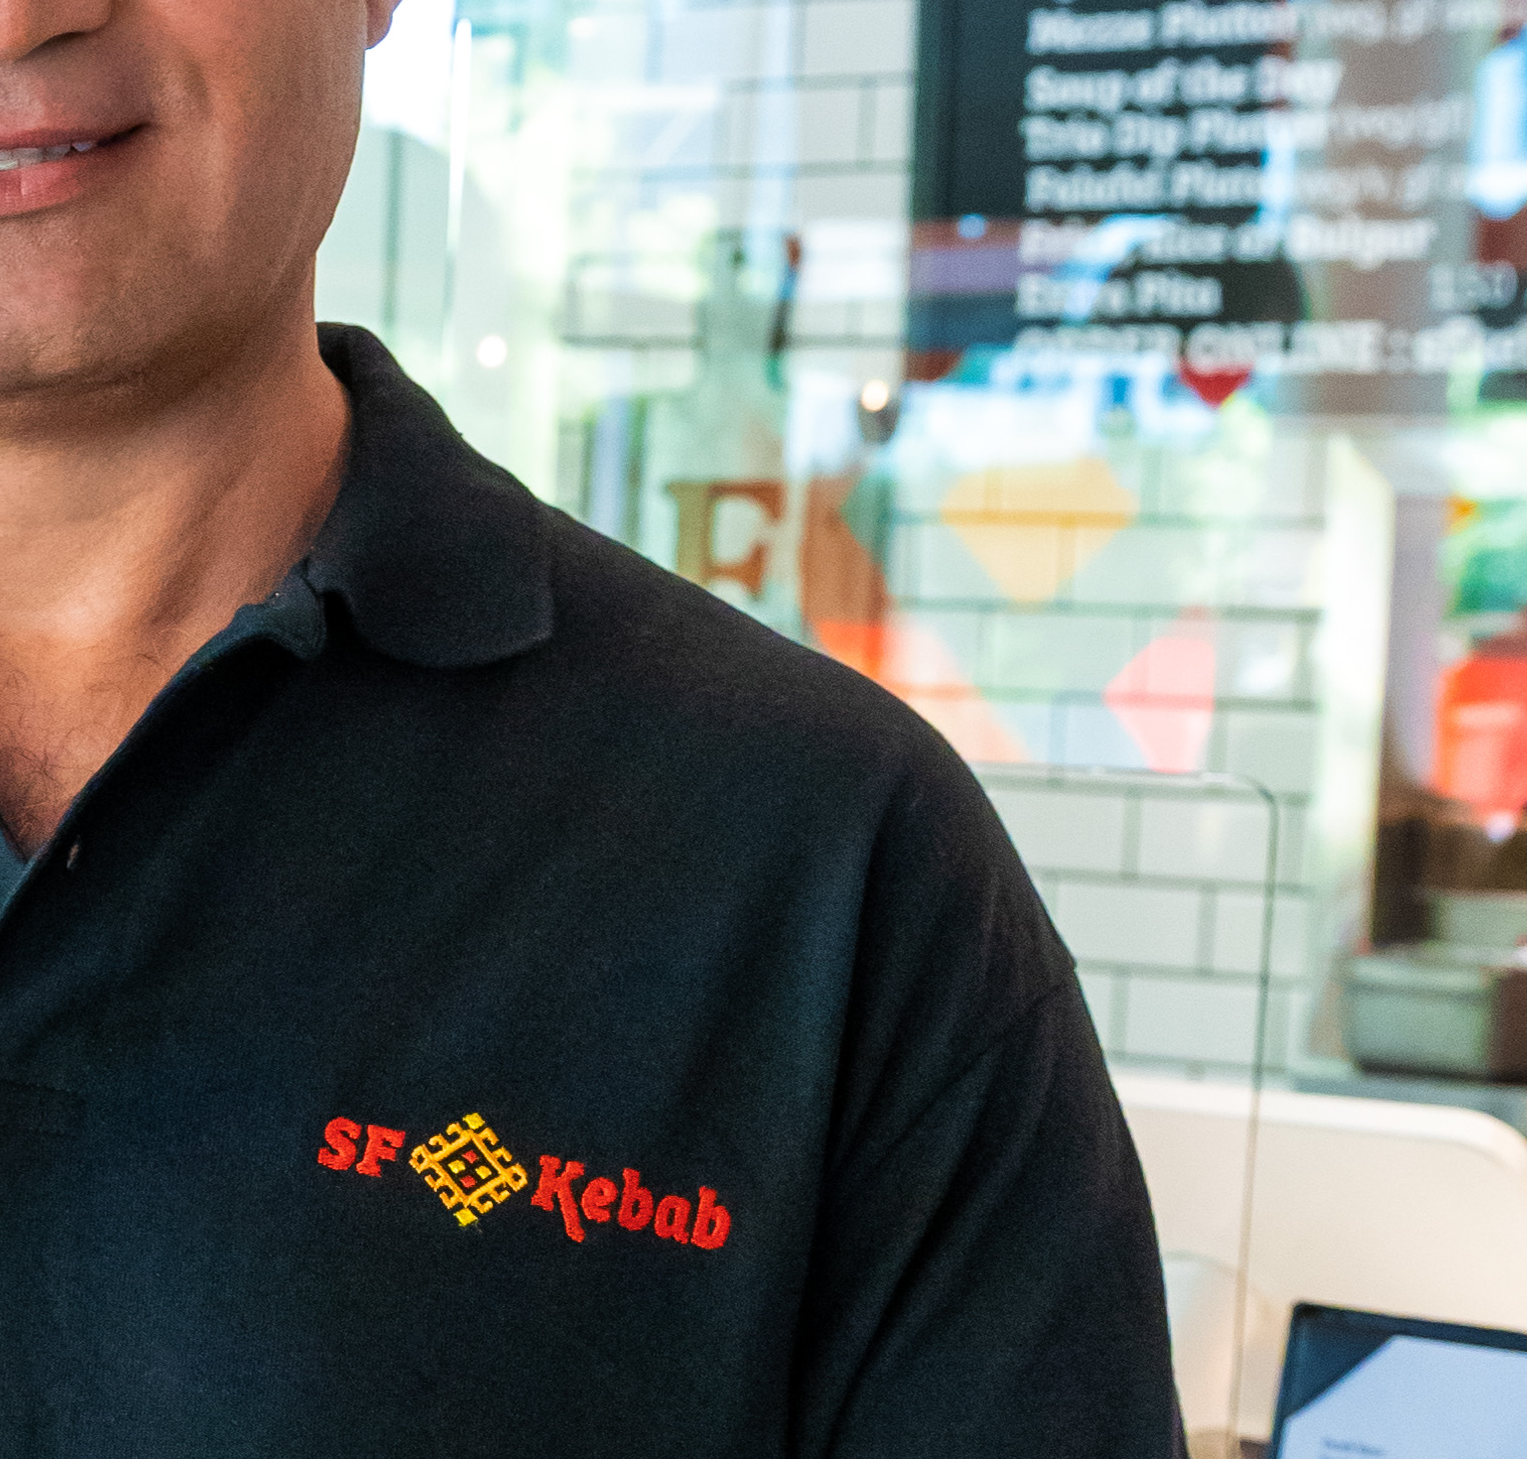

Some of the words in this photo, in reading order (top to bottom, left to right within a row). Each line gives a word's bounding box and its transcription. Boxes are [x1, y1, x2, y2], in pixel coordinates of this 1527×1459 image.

[1130, 56, 1176, 110] of
[1180, 55, 1251, 110] the
[317, 1116, 407, 1179] SF
[530, 1154, 732, 1250] Kebab
